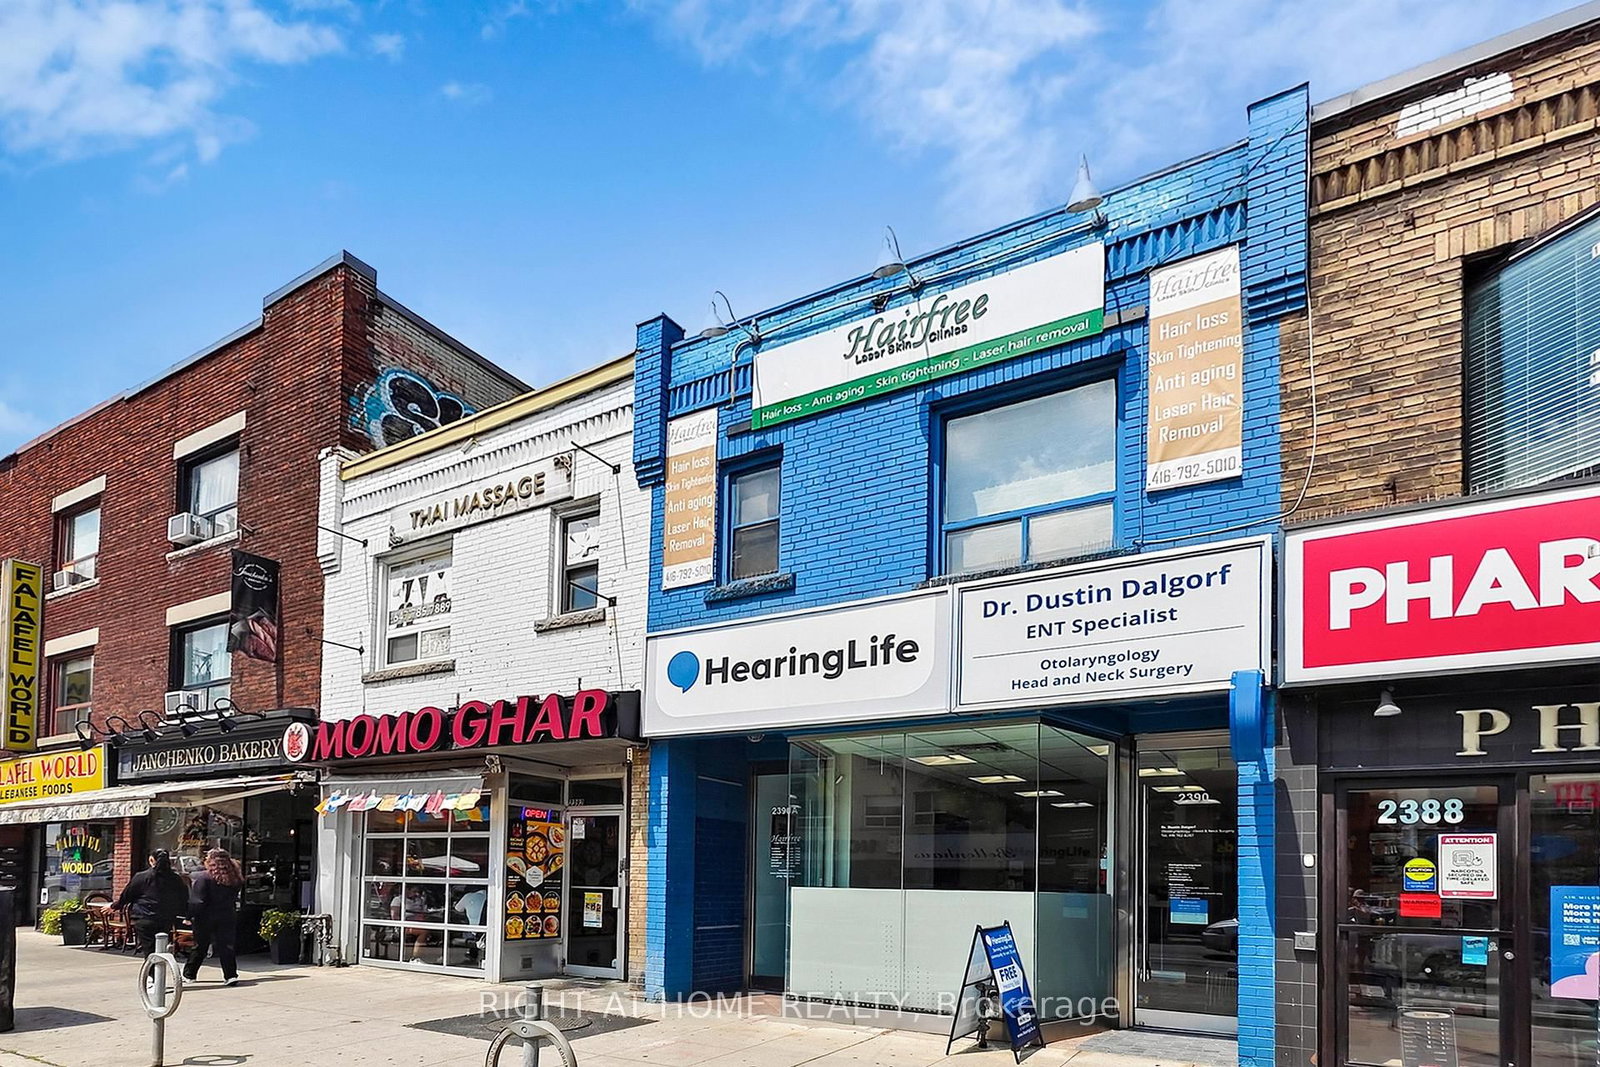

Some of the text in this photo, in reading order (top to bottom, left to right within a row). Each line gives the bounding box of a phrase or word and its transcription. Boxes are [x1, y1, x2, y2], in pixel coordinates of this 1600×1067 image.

[844, 292, 989, 360] Hairfree
[1159, 311, 1229, 341] Hair loss
[855, 324, 968, 365] Laser Skin Clinics
[1149, 333, 1242, 366] Skin Tightening
[761, 407, 782, 421] Hair
[783, 402, 802, 415] loss
[812, 393, 833, 407] Anti
[834, 384, 865, 402] aging
[876, 374, 898, 389] Skin
[899, 355, 960, 383] tightening
[972, 345, 1005, 361] Laser
[1007, 336, 1032, 353] hair
[1035, 318, 1089, 343] removal
[1154, 362, 1236, 394] Anti aging
[1154, 392, 1235, 422] Laser Hair
[1159, 414, 1224, 444] Removal
[672, 455, 710, 475] Hair loss
[1152, 456, 1237, 485] 416-792-5010
[410, 471, 546, 530] THAI MASSAGE
[666, 482, 680, 492] Skin
[667, 494, 713, 513] Anti aging
[667, 515, 712, 536] Laser Hair
[669, 533, 705, 553] Removal
[665, 563, 712, 582] 416-792-5010
[1329, 536, 1600, 630] PHAR
[983, 563, 1232, 618] Dr. Dustin Dalgorf
[1027, 606, 1178, 639] ENT Specialist
[9, 568, 38, 744] FALAFEL WORLD
[705, 634, 919, 685] HearingLife
[1041, 648, 1160, 671] Otolaryngology
[1011, 662, 1194, 690] Head and Neck Surgery
[311, 688, 609, 761] MOMO GHAR
[41, 753, 97, 779] WORLD
[133, 737, 282, 771] JANCHENKO BAKERY
[0, 783, 73, 799] LEBANESE FOODS
[1178, 792, 1210, 801] 2390
[525, 809, 547, 818] OPEN
[771, 806, 799, 815] 2390A
[1377, 798, 1465, 825] 2388
[61, 862, 93, 874] WORLD
[1563, 902, 1591, 910] More
[1563, 909, 1591, 917] More
[1563, 916, 1591, 924] More
[999, 965, 1018, 983] FREE
